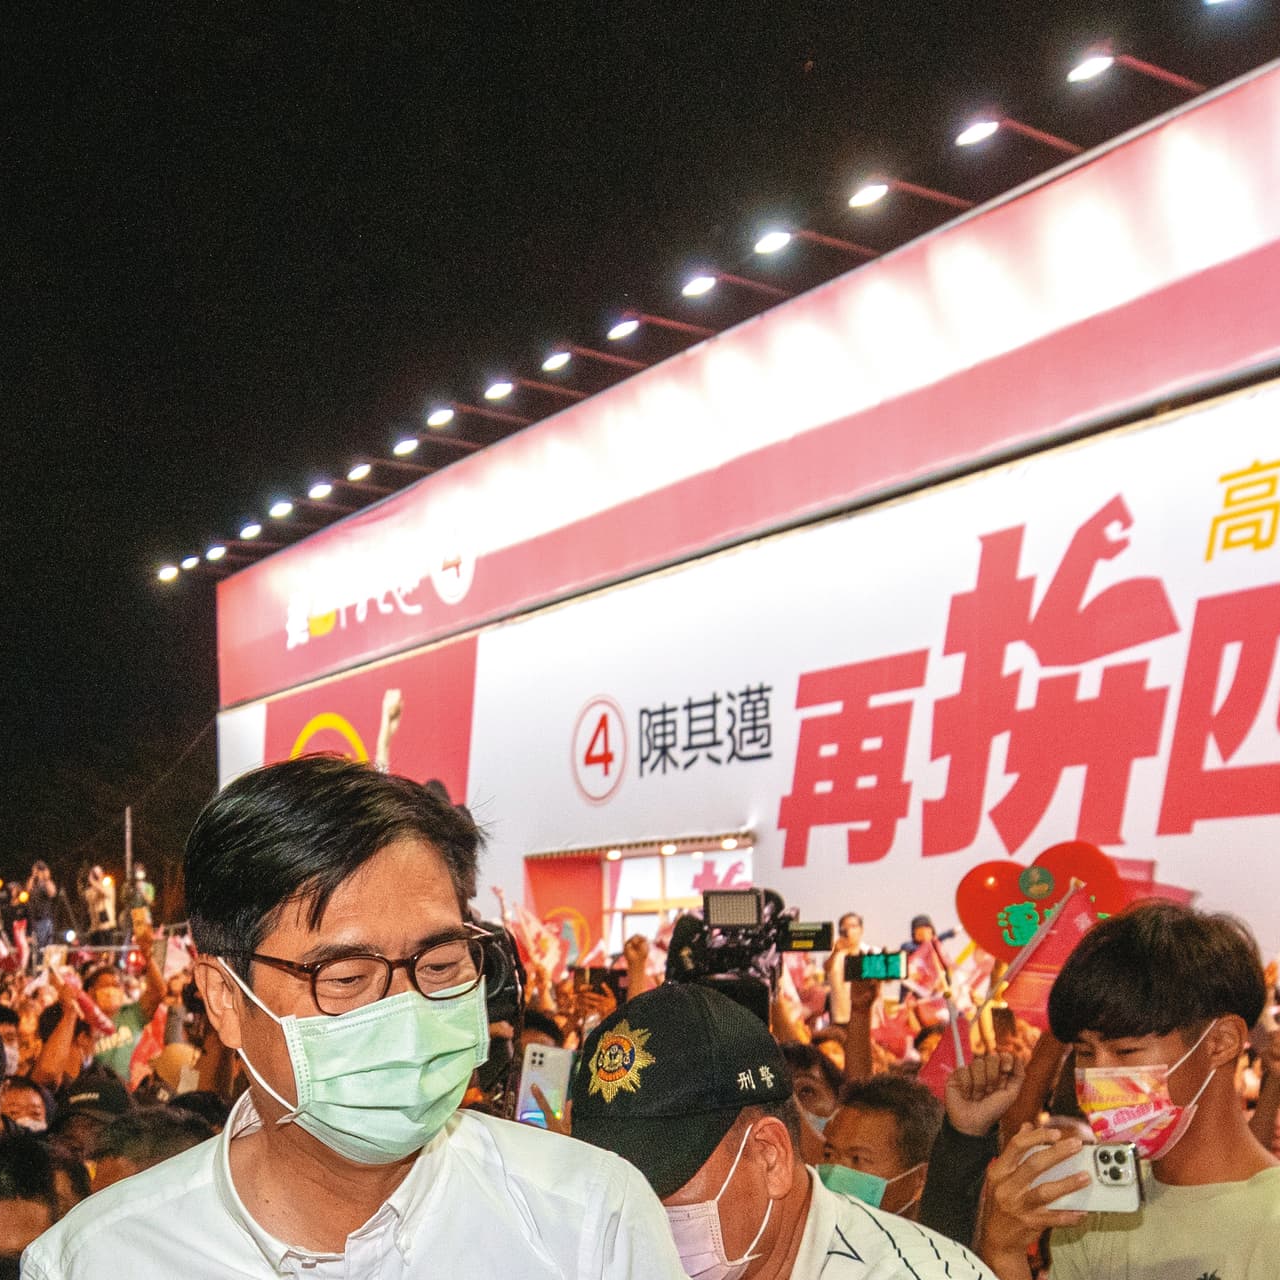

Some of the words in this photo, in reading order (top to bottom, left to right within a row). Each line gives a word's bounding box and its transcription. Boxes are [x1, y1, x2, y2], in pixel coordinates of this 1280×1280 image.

[584, 712, 614, 777] 4
[638, 682, 774, 779] 陳其邁
[737, 1065, 775, 1090] 刑警
